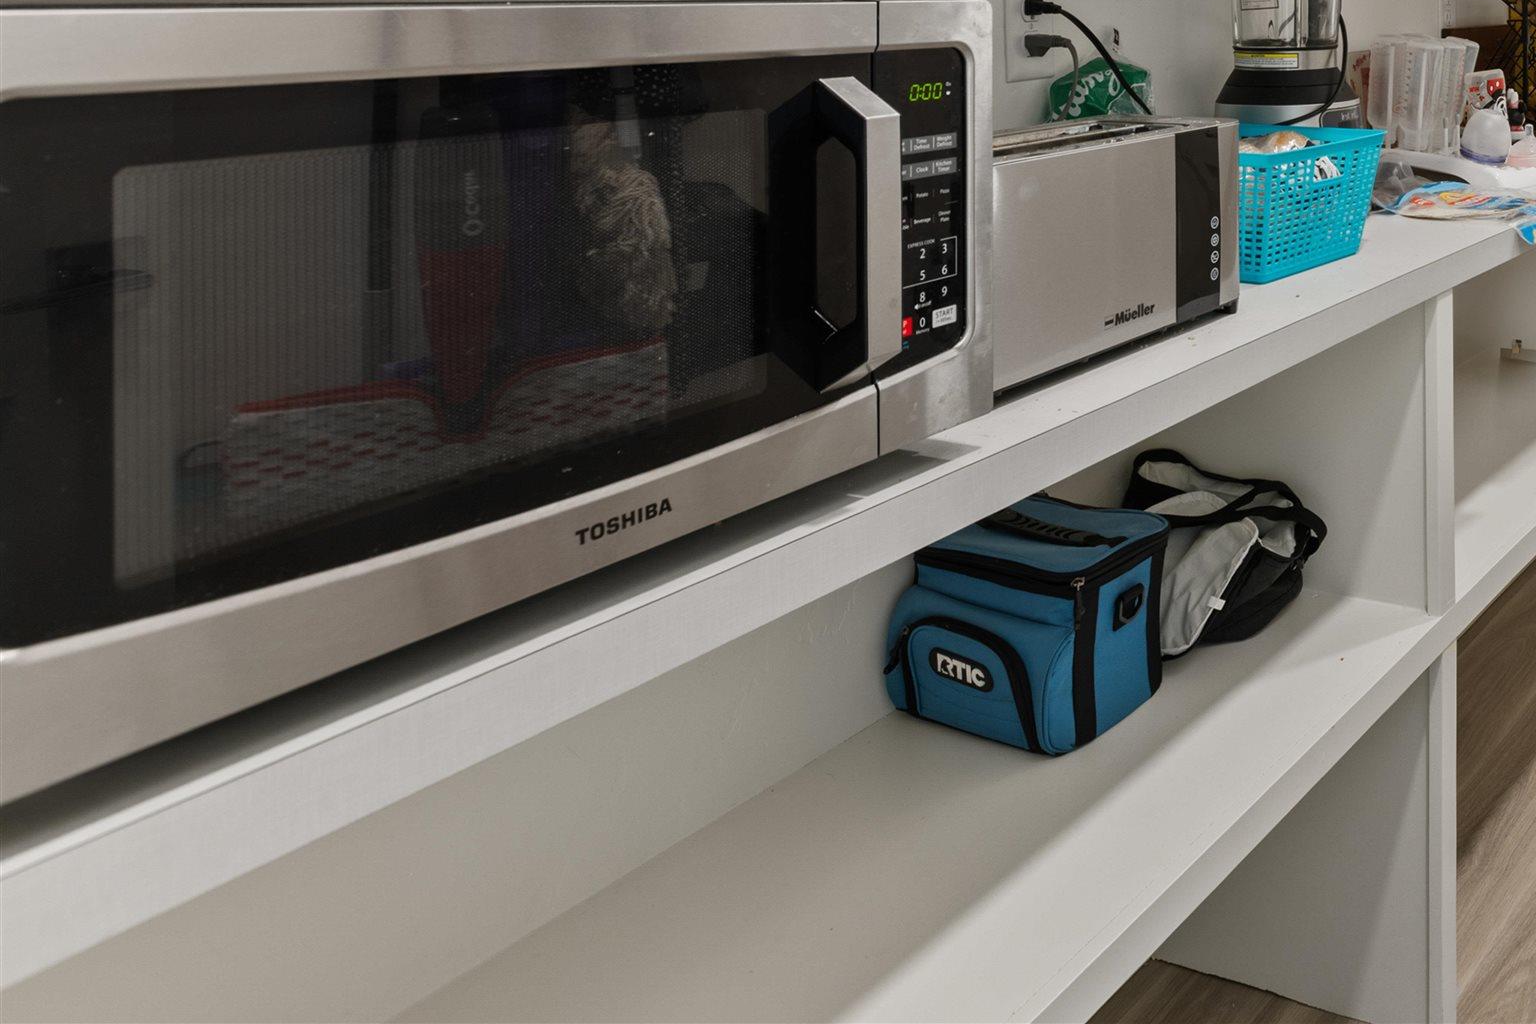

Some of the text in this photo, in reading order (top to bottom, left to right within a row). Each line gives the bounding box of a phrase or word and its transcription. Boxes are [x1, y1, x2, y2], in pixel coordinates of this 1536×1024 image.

[909, 82, 943, 102] 0:00
[915, 166, 929, 174] Clock
[924, 238, 936, 246] COOK
[919, 248, 927, 260] 2
[941, 242, 949, 255] 3
[919, 269, 926, 281] 5
[941, 264, 948, 276] 6
[919, 291, 926, 303] 8
[941, 286, 948, 297] 9
[935, 307, 954, 319] START
[1114, 302, 1156, 326] Müeller
[919, 317, 926, 328] 0
[574, 497, 673, 546] TOSHIBA
[936, 652, 986, 688] RTIC
